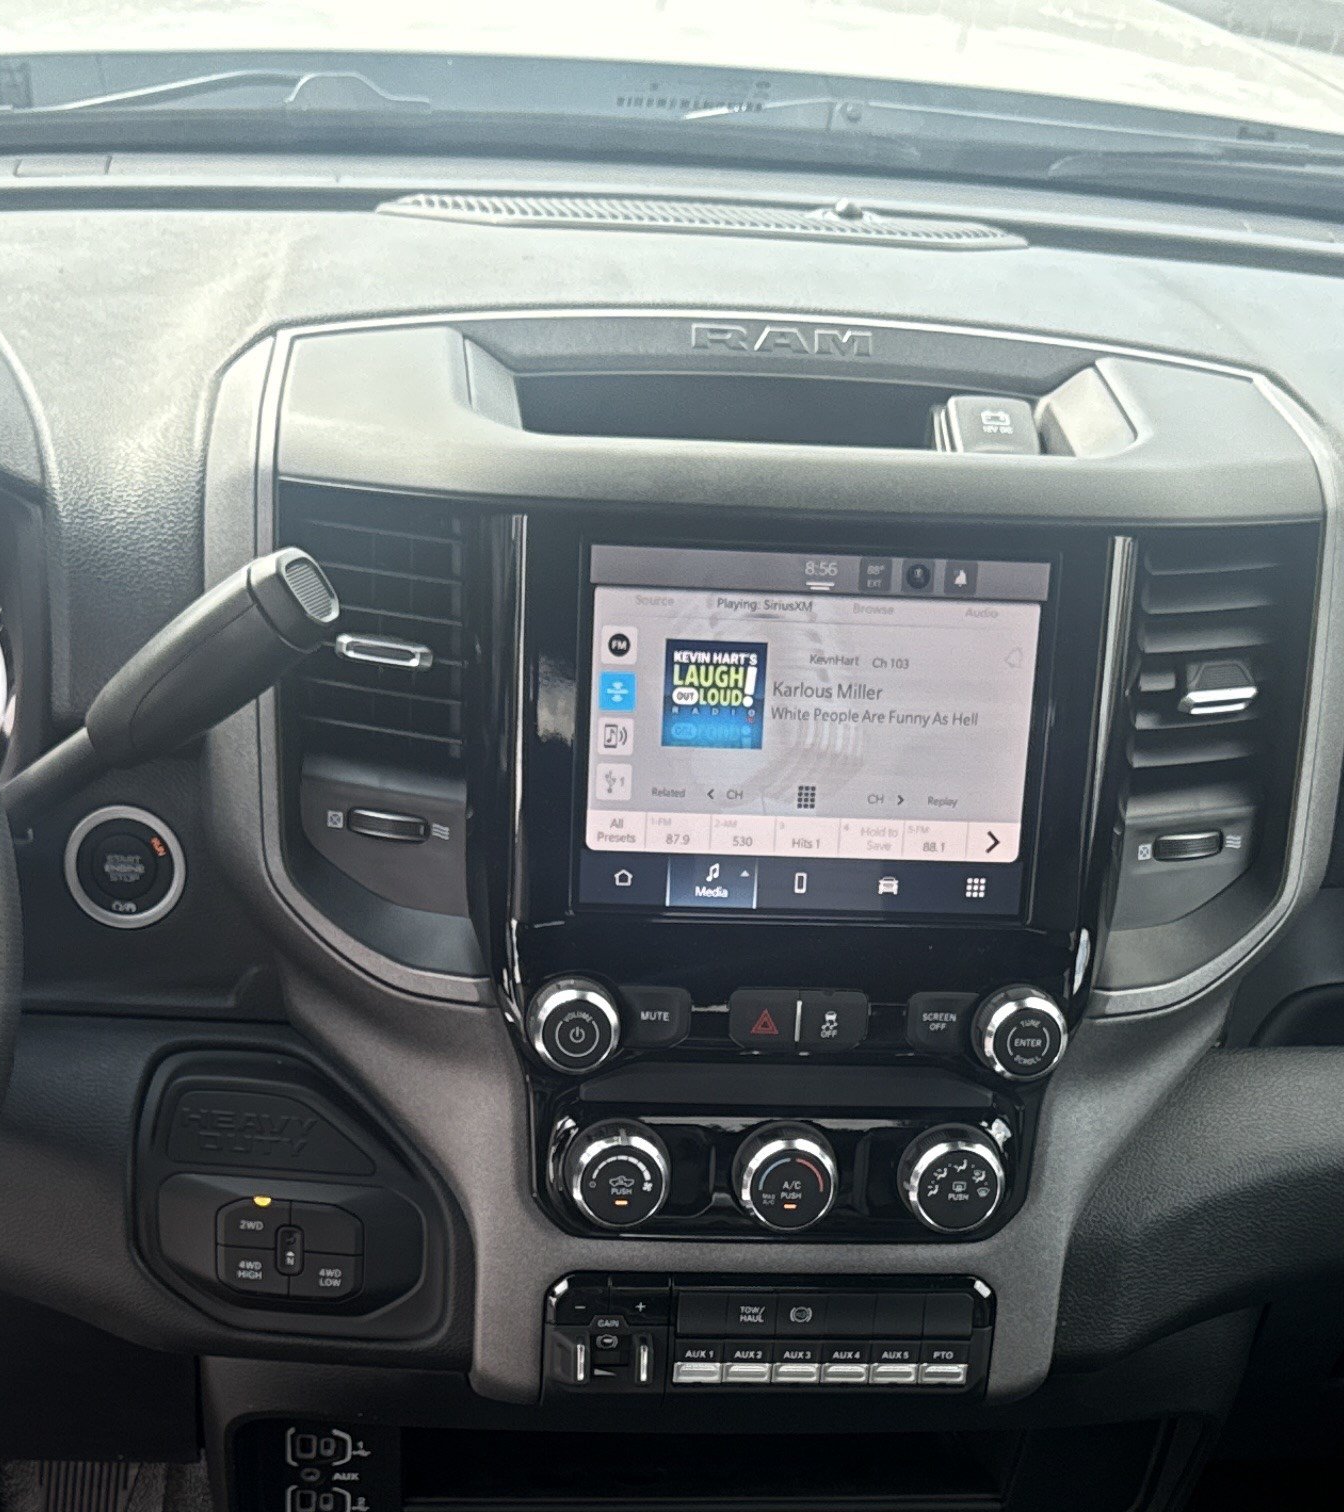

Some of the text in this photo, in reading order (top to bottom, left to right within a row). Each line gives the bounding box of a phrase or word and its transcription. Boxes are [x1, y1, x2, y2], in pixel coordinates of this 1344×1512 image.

[691, 322, 873, 357] RAM
[805, 560, 838, 577] 8:56
[763, 599, 814, 612] SiriusXM
[852, 603, 895, 616] Browse
[964, 607, 999, 619] Audio
[611, 640, 627, 651] FM
[673, 650, 758, 666] KEVIN HART'S
[872, 657, 888, 669] Ch
[889, 658, 910, 670] 103
[673, 664, 744, 688] LAUGH
[772, 681, 883, 701] Karlous Miller
[771, 707, 979, 728] White People Are Funny As Hell
[651, 787, 686, 798] Related
[726, 789, 743, 801] CH
[867, 793, 884, 805] CH
[927, 796, 958, 809] Replay
[609, 818, 623, 829] All
[596, 831, 637, 844] Presets
[665, 834, 691, 846] 87.9
[732, 835, 754, 847] 530
[791, 838, 815, 849] Hits
[695, 885, 729, 898] Media
[640, 1011, 670, 1023] MUTE
[922, 1012, 957, 1023] SCREEN
[929, 1022, 946, 1032] OFF
[820, 1028, 838, 1039] OFF
[1014, 1038, 1043, 1049] ENTER
[610, 1186, 633, 1196] PUSH
[782, 1180, 802, 1191] A/C
[780, 1191, 802, 1201] PUSH
[947, 1192, 970, 1202] PUSH
[239, 1219, 264, 1231] 2WD
[238, 1260, 262, 1270] 4WD
[237, 1270, 263, 1280] HIGH
[318, 1268, 342, 1278] 4WD
[319, 1278, 342, 1287] LOW
[597, 1319, 620, 1329] GAIN
[739, 1314, 765, 1323] HAUL
[684, 1350, 706, 1358] AUX
[734, 1351, 755, 1359] AUX
[783, 1351, 804, 1359] AUX
[832, 1351, 853, 1359] AUX
[881, 1352, 902, 1360] AUX
[932, 1351, 954, 1360] PTO
[332, 1472, 360, 1481] AUX
